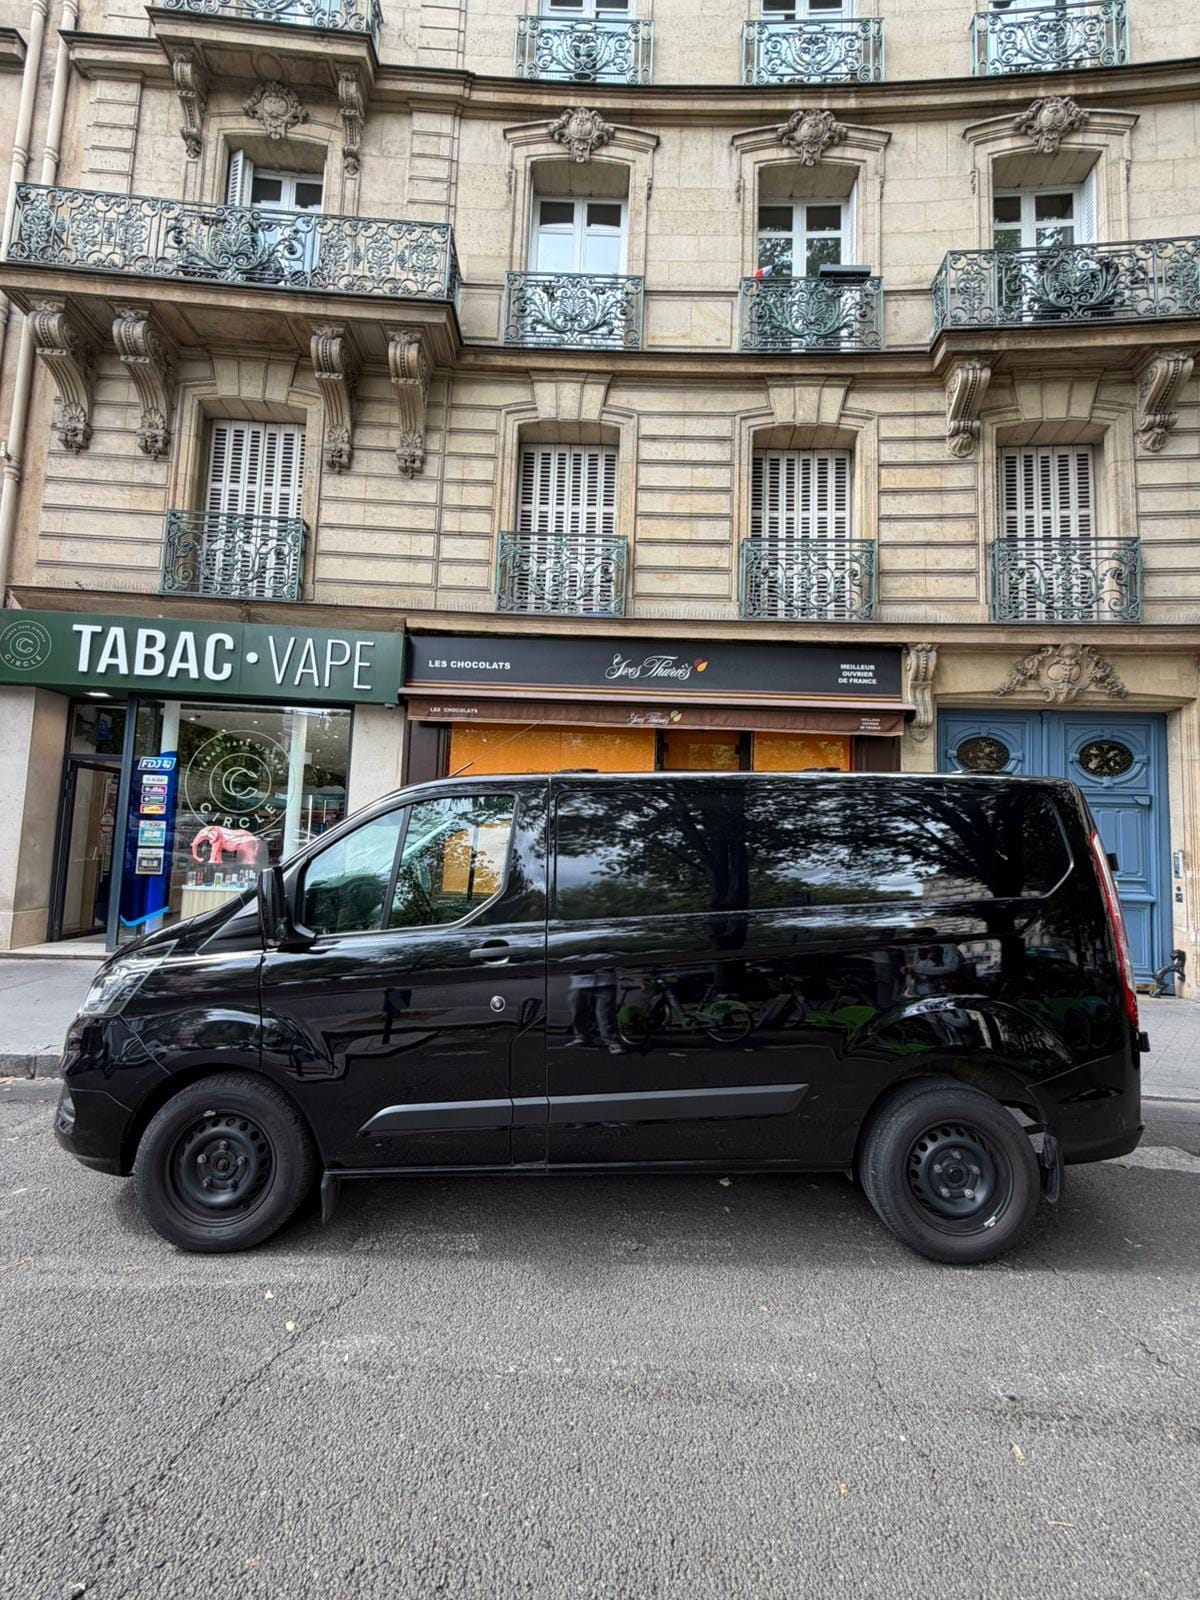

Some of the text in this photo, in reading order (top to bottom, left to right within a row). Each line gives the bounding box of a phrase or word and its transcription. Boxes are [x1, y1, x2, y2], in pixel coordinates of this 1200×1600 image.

[72, 624, 375, 691] TABAC VAPE
[428, 659, 511, 670] LES CHOCOLATS
[605, 653, 642, 679] Yves
[840, 663, 875, 671] MEILLEUR
[141, 759, 162, 768] FDJ
[200, 802, 276, 828] CIRCLE
